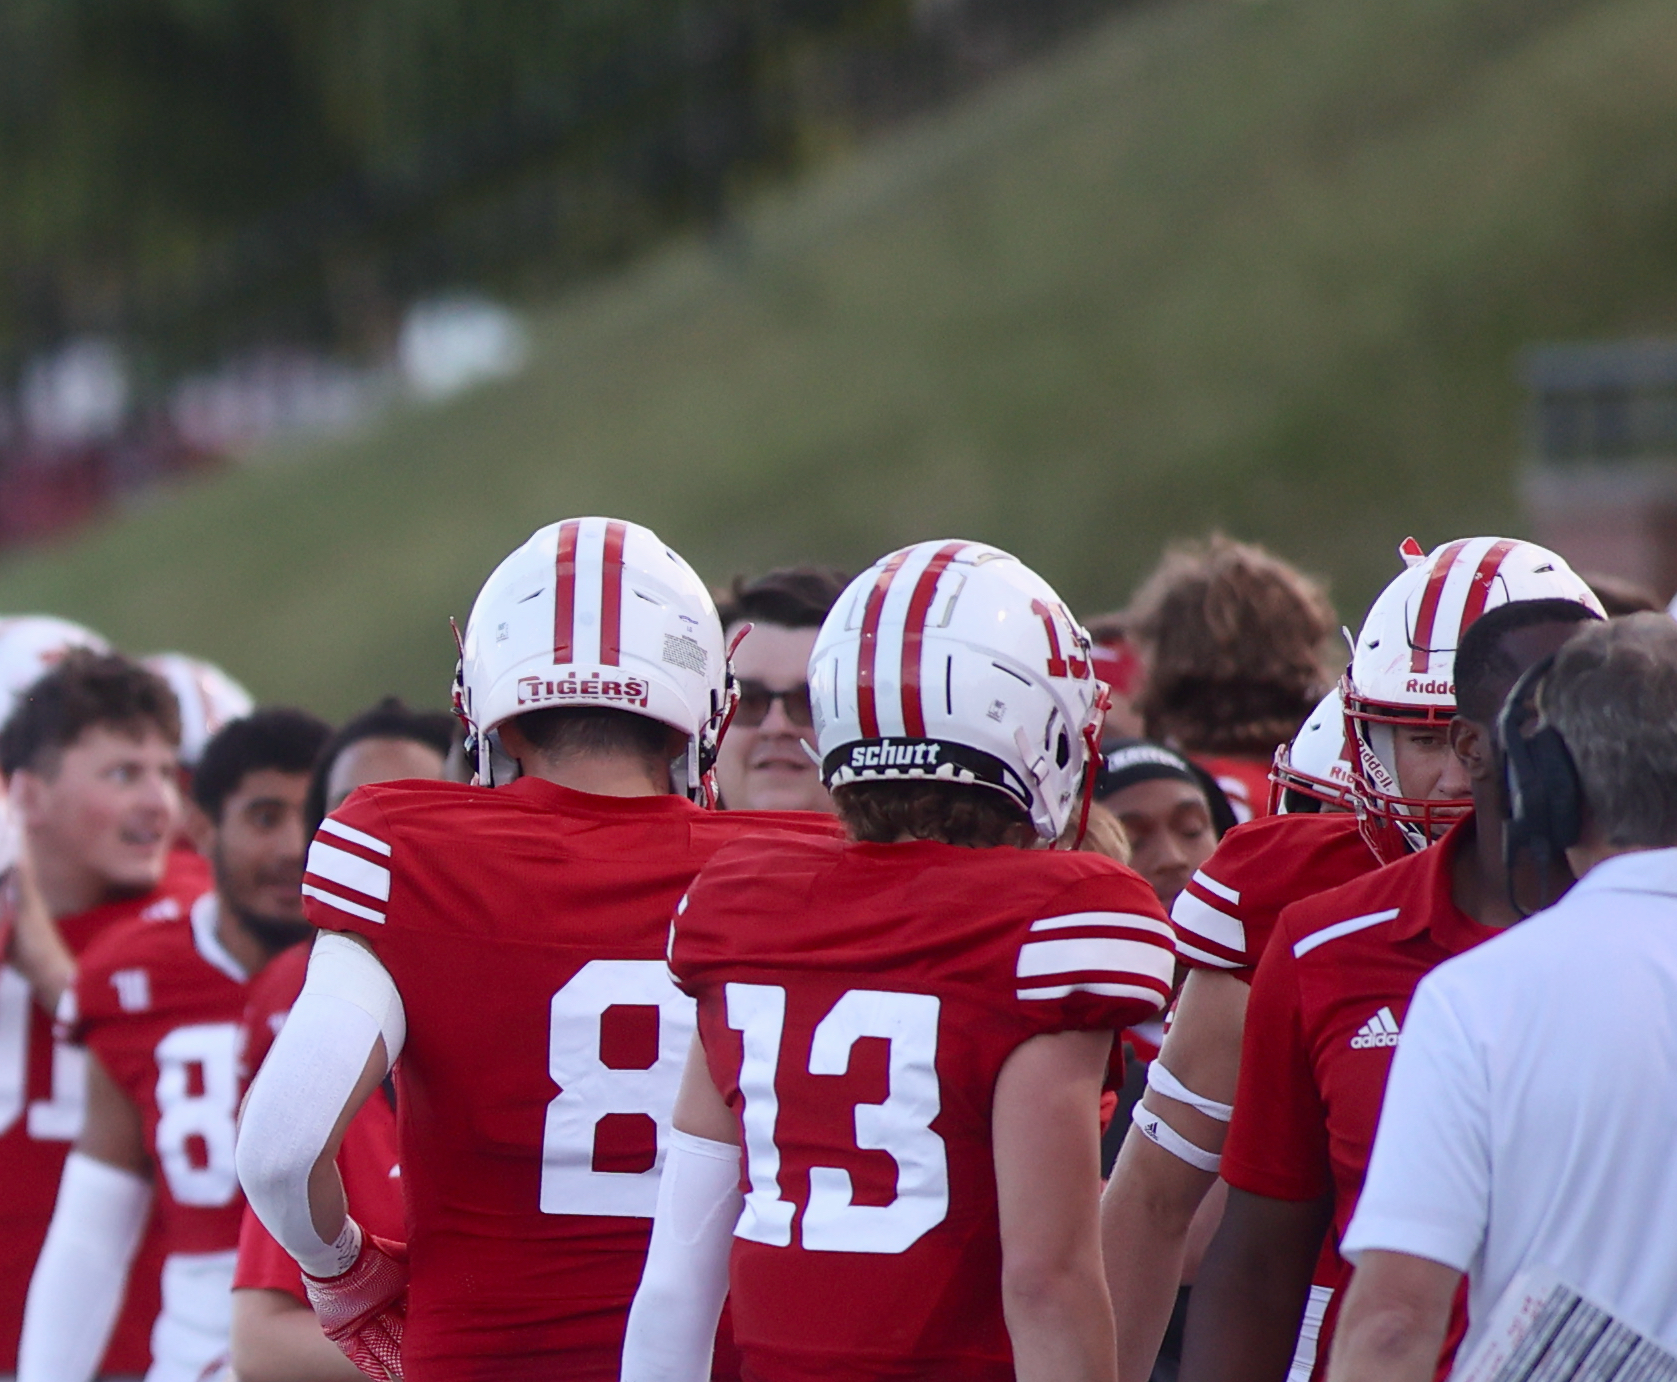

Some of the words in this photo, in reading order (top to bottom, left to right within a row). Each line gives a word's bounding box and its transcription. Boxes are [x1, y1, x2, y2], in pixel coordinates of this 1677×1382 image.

[527, 680, 642, 697] TIGERS
[1406, 678, 1456, 695] Ridde
[851, 739, 941, 767] schutt
[1350, 1034, 1398, 1049] adida
[540, 959, 696, 1218] 8
[725, 982, 949, 1255] 13
